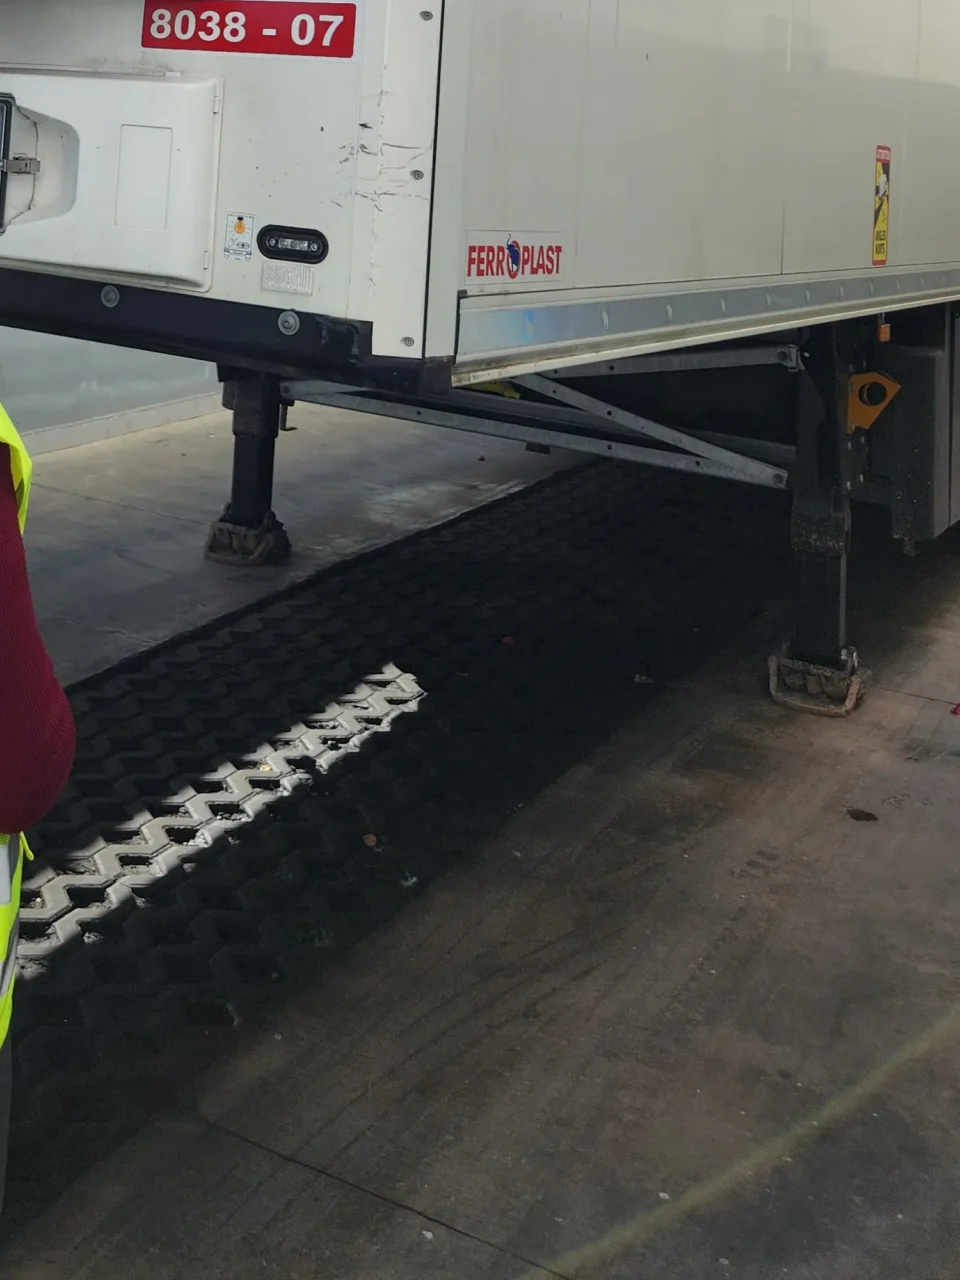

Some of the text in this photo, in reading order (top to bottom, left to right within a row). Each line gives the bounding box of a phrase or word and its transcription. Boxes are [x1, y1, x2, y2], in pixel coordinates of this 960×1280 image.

[150, 8, 344, 47] 8038 - 07
[466, 240, 562, 279] FERROPLAST
